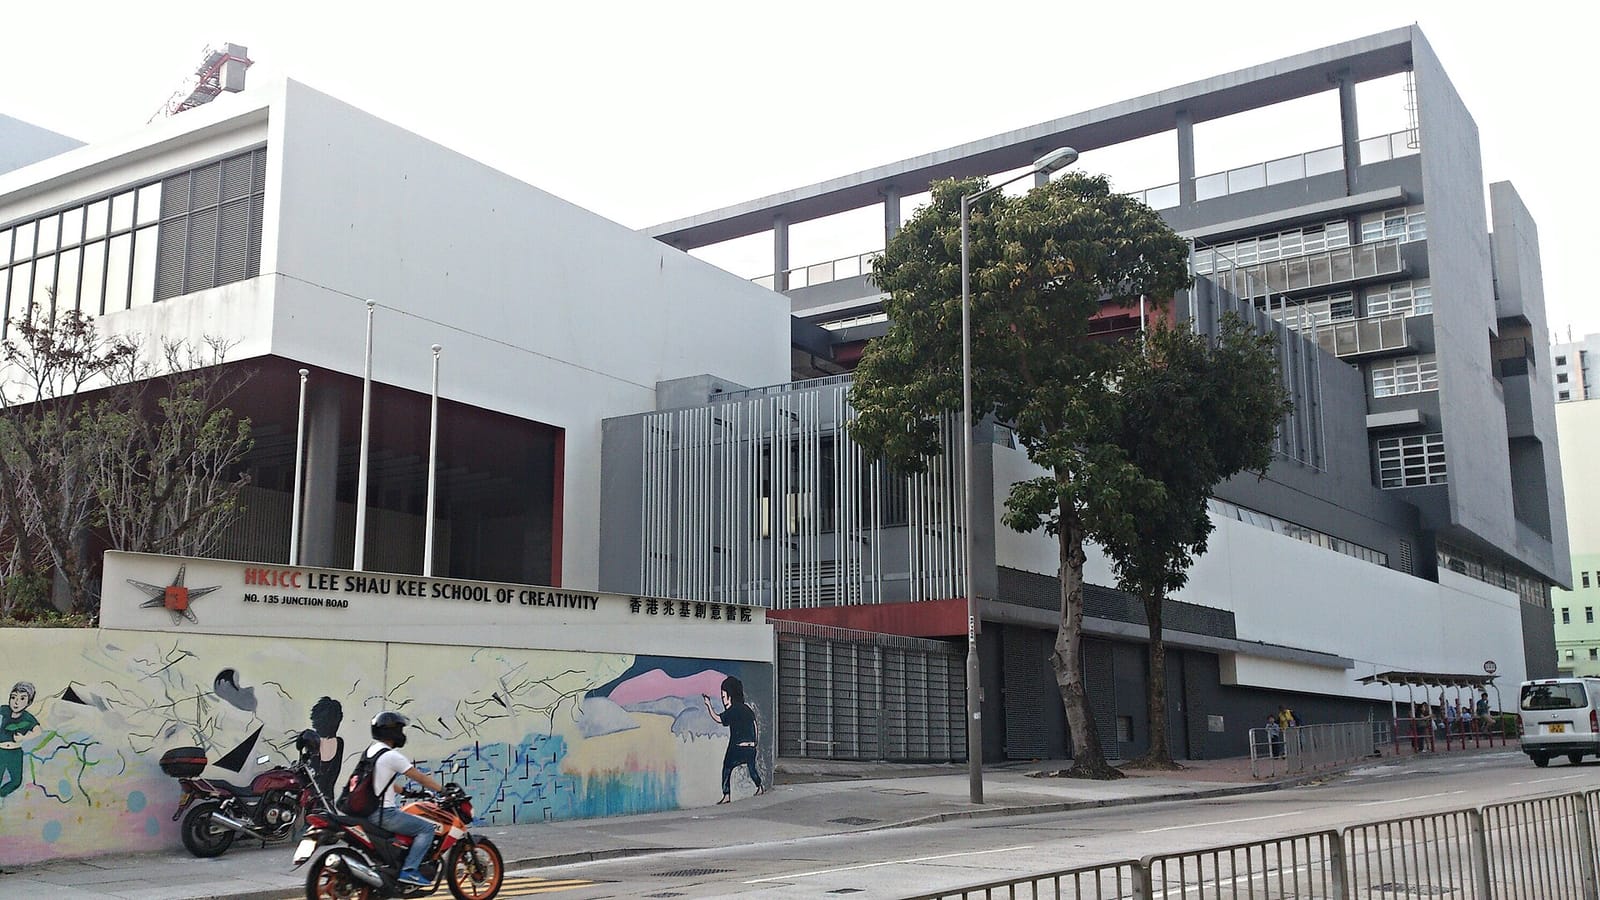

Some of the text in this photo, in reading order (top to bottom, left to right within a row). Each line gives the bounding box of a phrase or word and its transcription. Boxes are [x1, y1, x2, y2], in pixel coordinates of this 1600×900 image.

[244, 567, 600, 611] HKICC LEE SHAU KEE SCHOOL OF CREATIVITY
[244, 593, 349, 609] NO. 135 JUNCTION ROAD
[630, 597, 752, 622] 香港兆基創意書院
